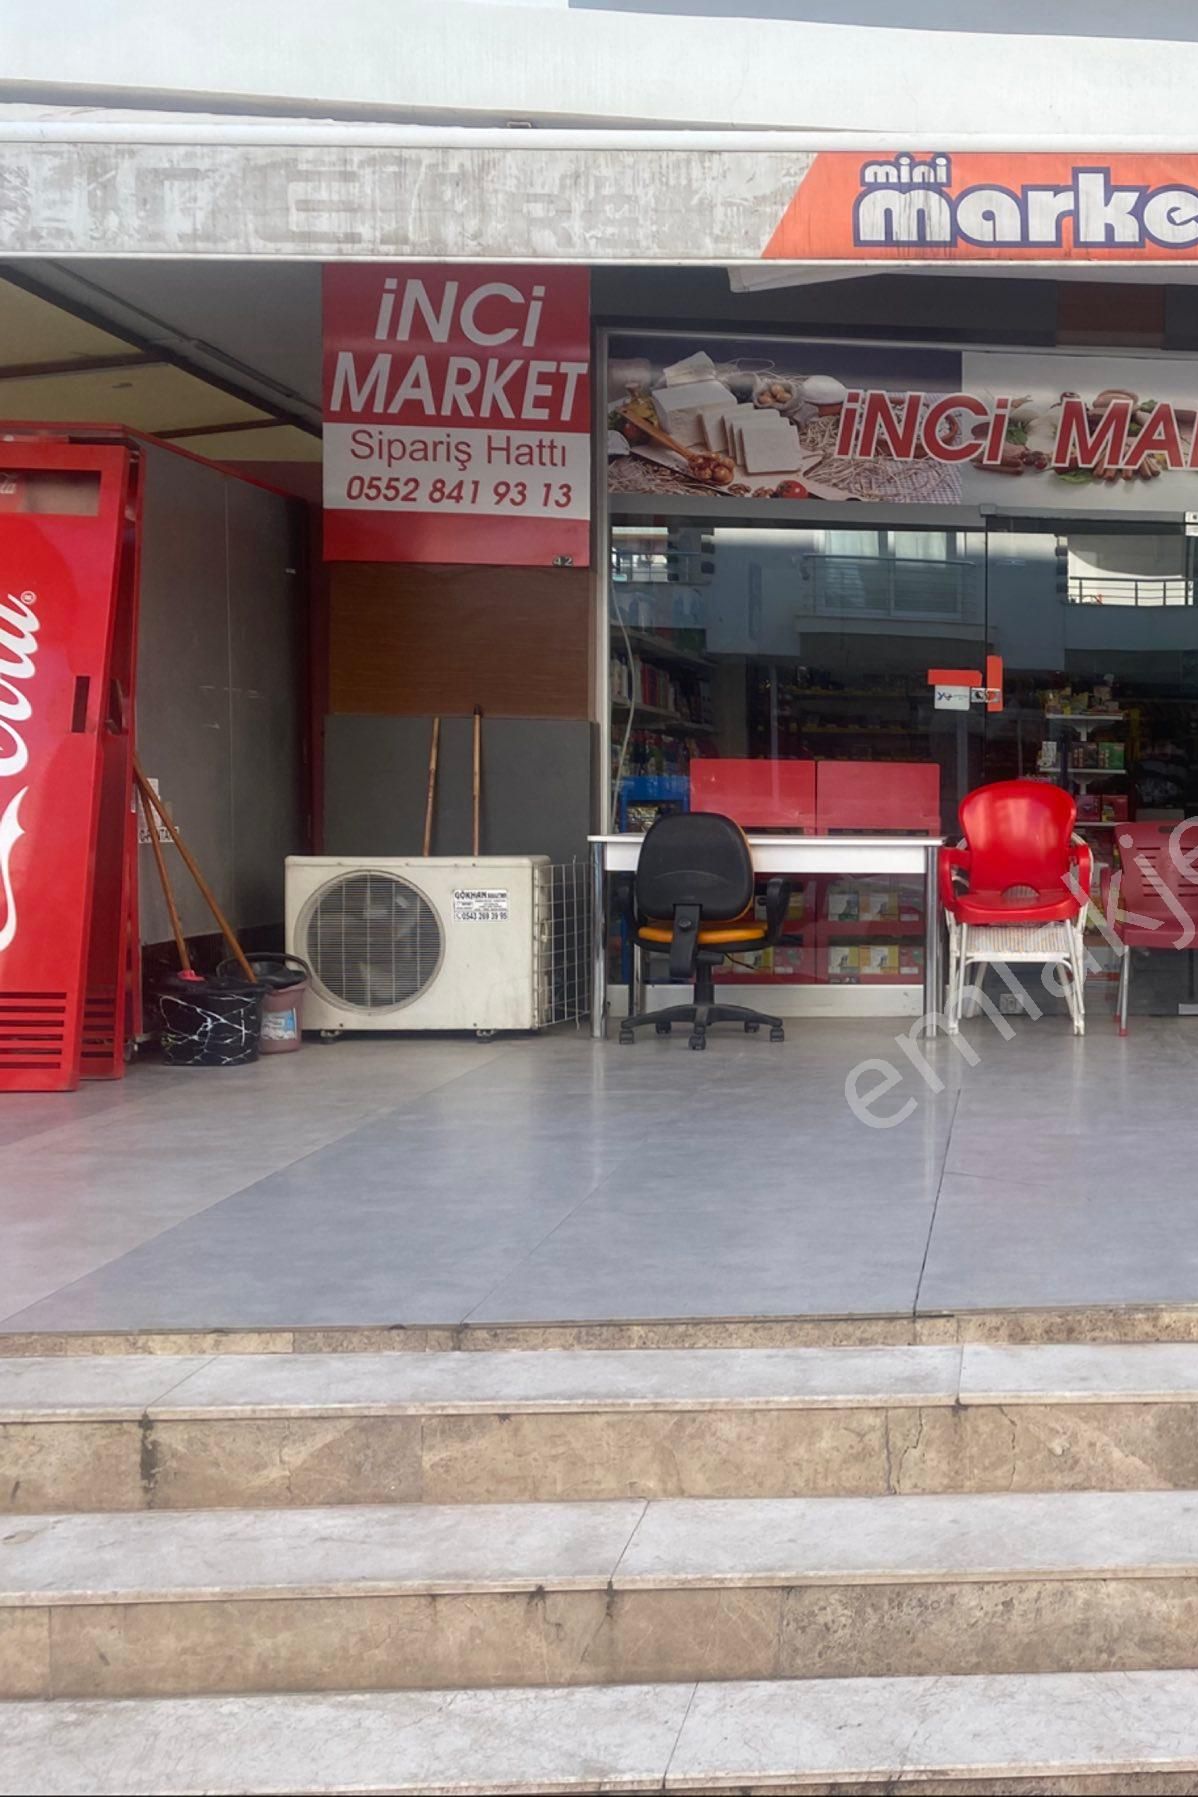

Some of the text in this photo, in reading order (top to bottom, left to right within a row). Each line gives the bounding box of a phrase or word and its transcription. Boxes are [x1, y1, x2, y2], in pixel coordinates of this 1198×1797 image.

[863, 153, 950, 183] mini
[330, 352, 589, 422] MARKET
[350, 429, 567, 472] Sipariş Hattı
[346, 475, 572, 508] 0552 841 93 13
